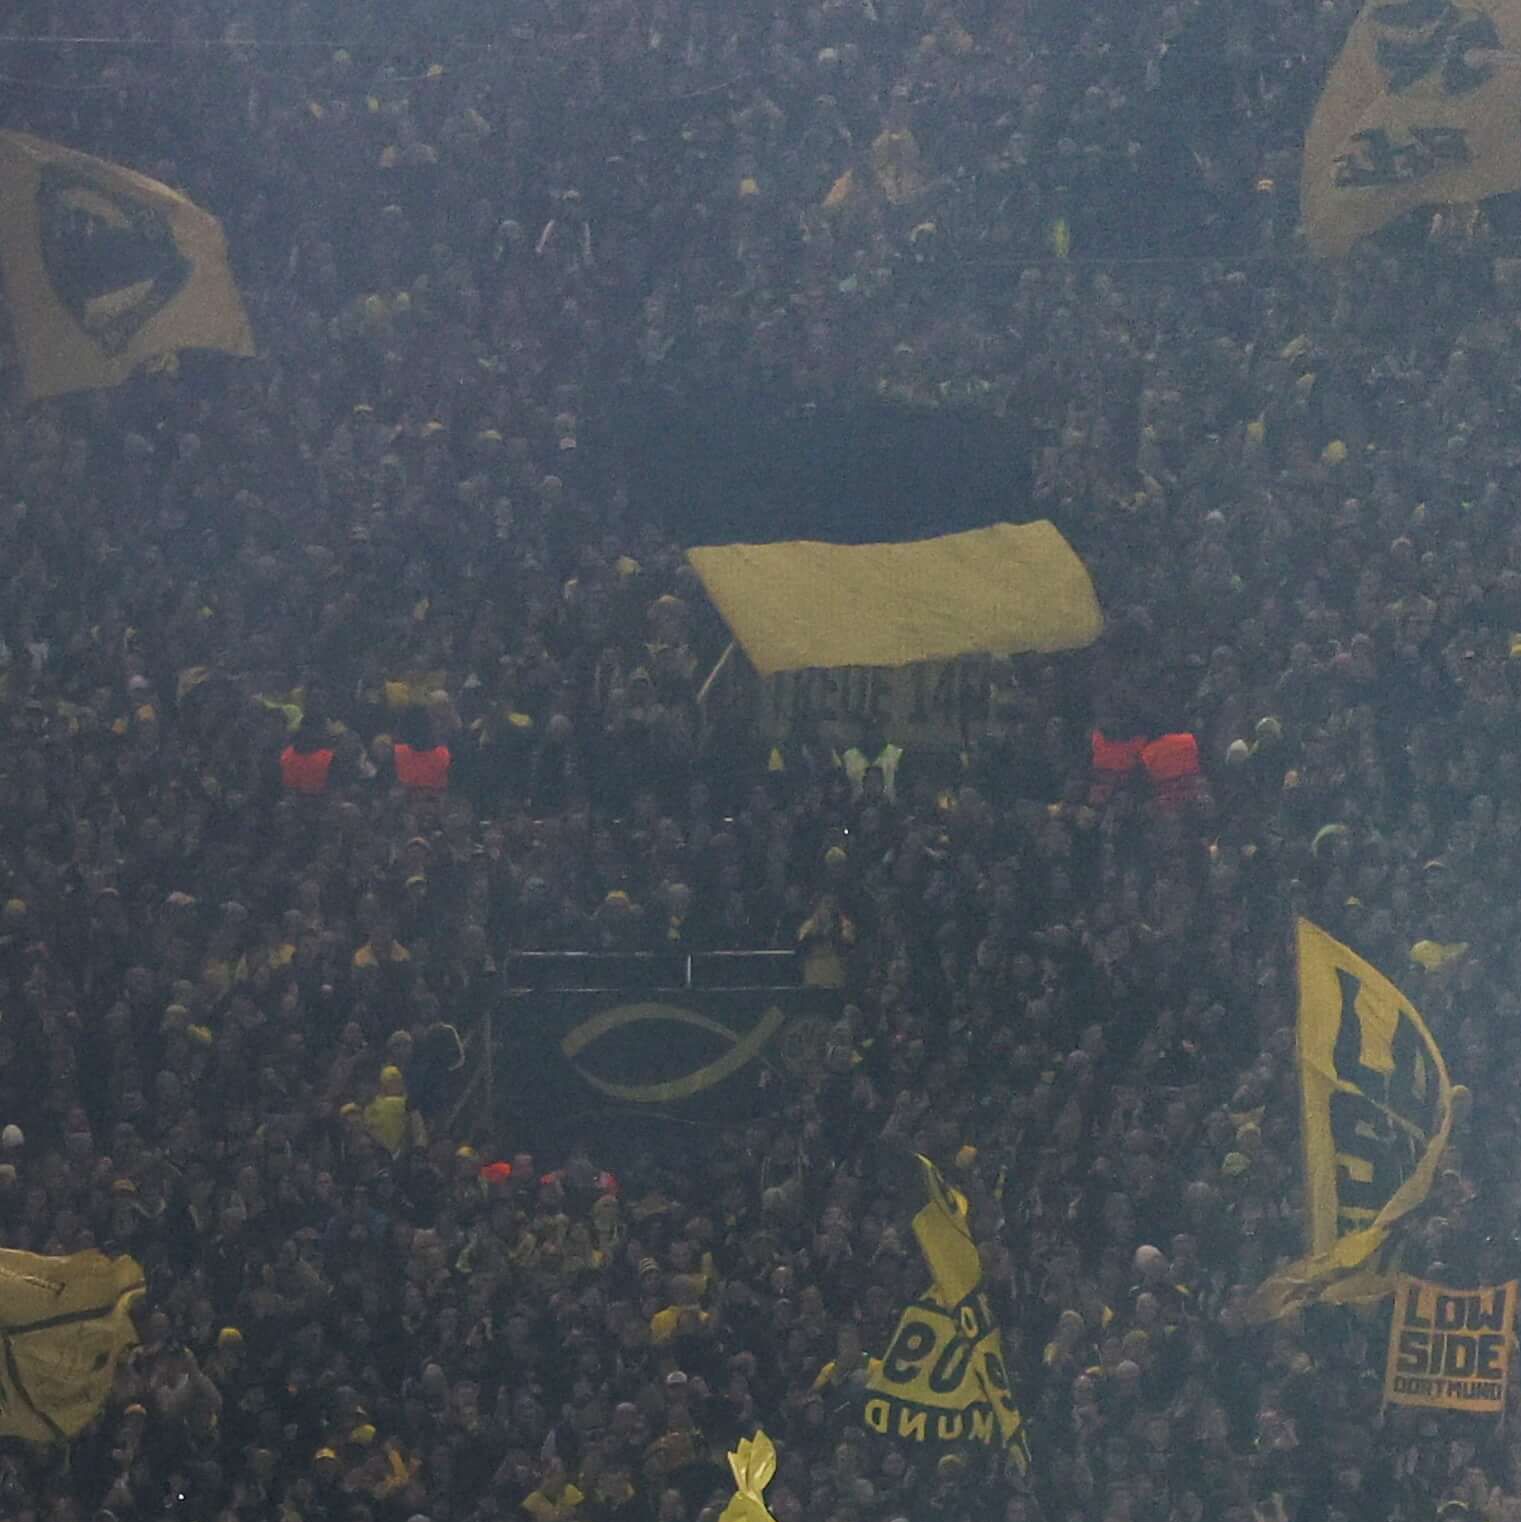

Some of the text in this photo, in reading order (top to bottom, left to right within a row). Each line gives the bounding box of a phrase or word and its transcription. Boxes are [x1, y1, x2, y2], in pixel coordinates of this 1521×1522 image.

[1405, 1283, 1507, 1330] LOW
[1398, 1330, 1506, 1379] SIDE
[1393, 1374, 1504, 1401] DORTMUND
